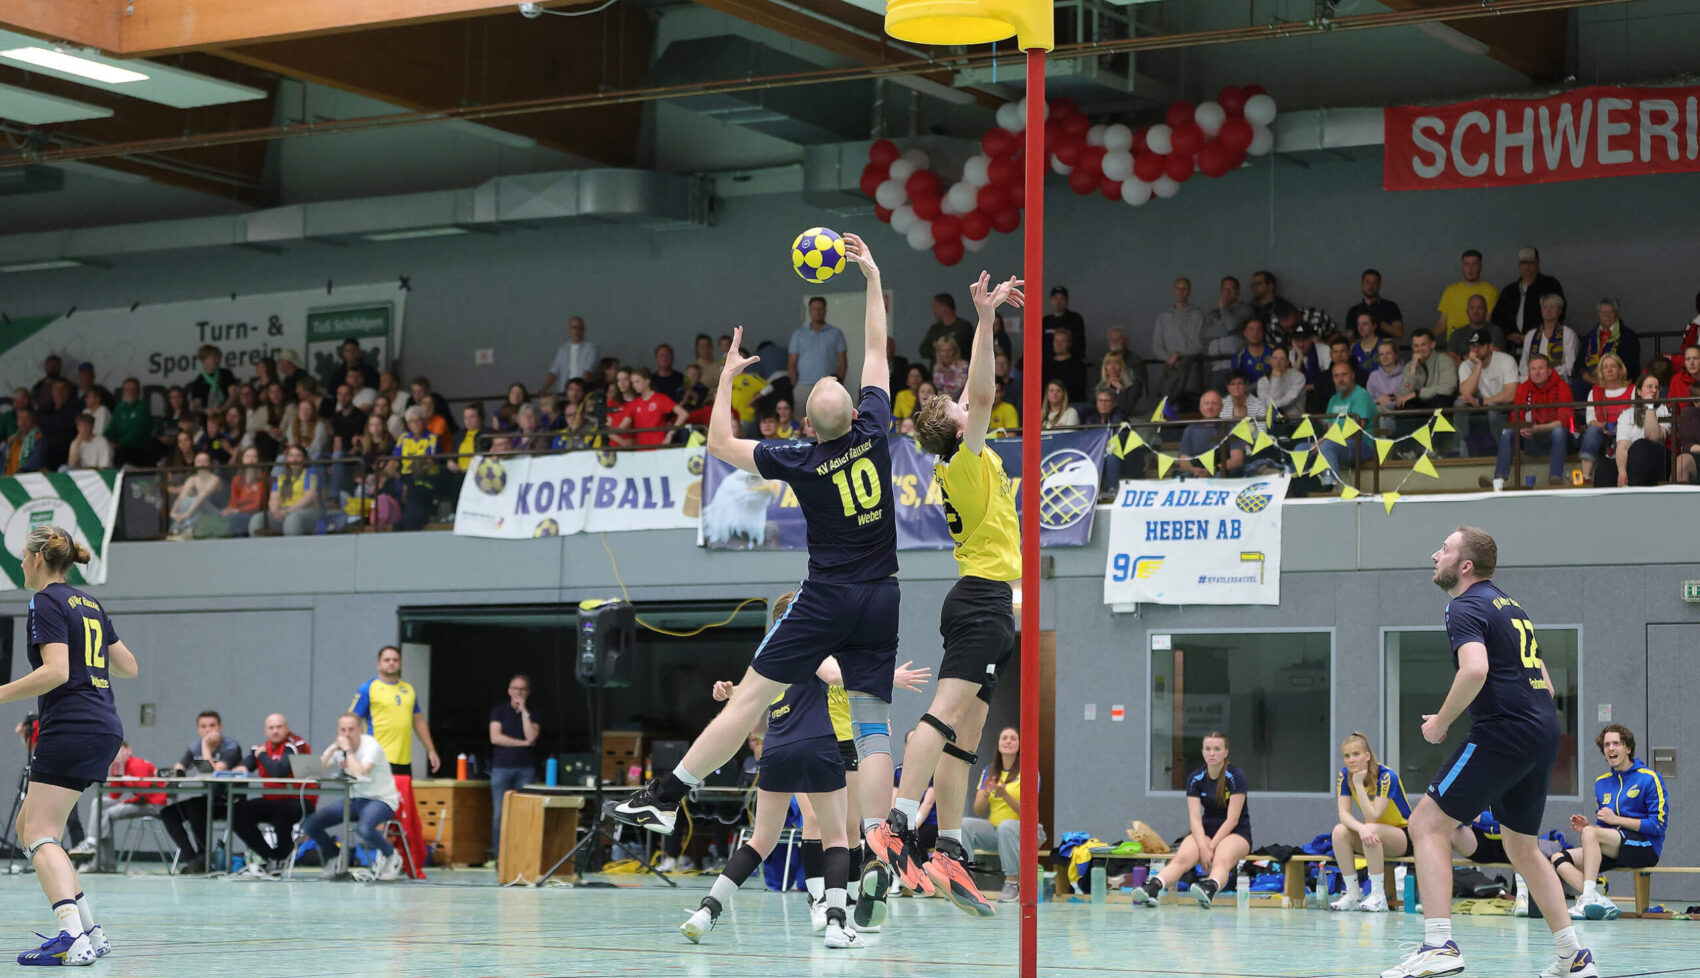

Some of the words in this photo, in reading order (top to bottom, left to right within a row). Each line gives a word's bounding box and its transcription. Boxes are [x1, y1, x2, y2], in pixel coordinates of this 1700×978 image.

[196, 321, 258, 342] Turn-
[267, 314, 284, 336] &
[149, 343, 282, 378] Sporerei
[816, 461, 829, 476] KV
[829, 452, 849, 471] Adler
[514, 475, 676, 515] KORFBALL
[832, 457, 881, 517] 10
[1121, 490, 1158, 508] DIE
[1160, 489, 1230, 507] ADLER
[858, 509, 883, 526] Weber
[1145, 520, 1209, 541] HEBEN
[1216, 519, 1242, 540] AB
[82, 616, 105, 668] 12
[1510, 618, 1541, 669] 12
